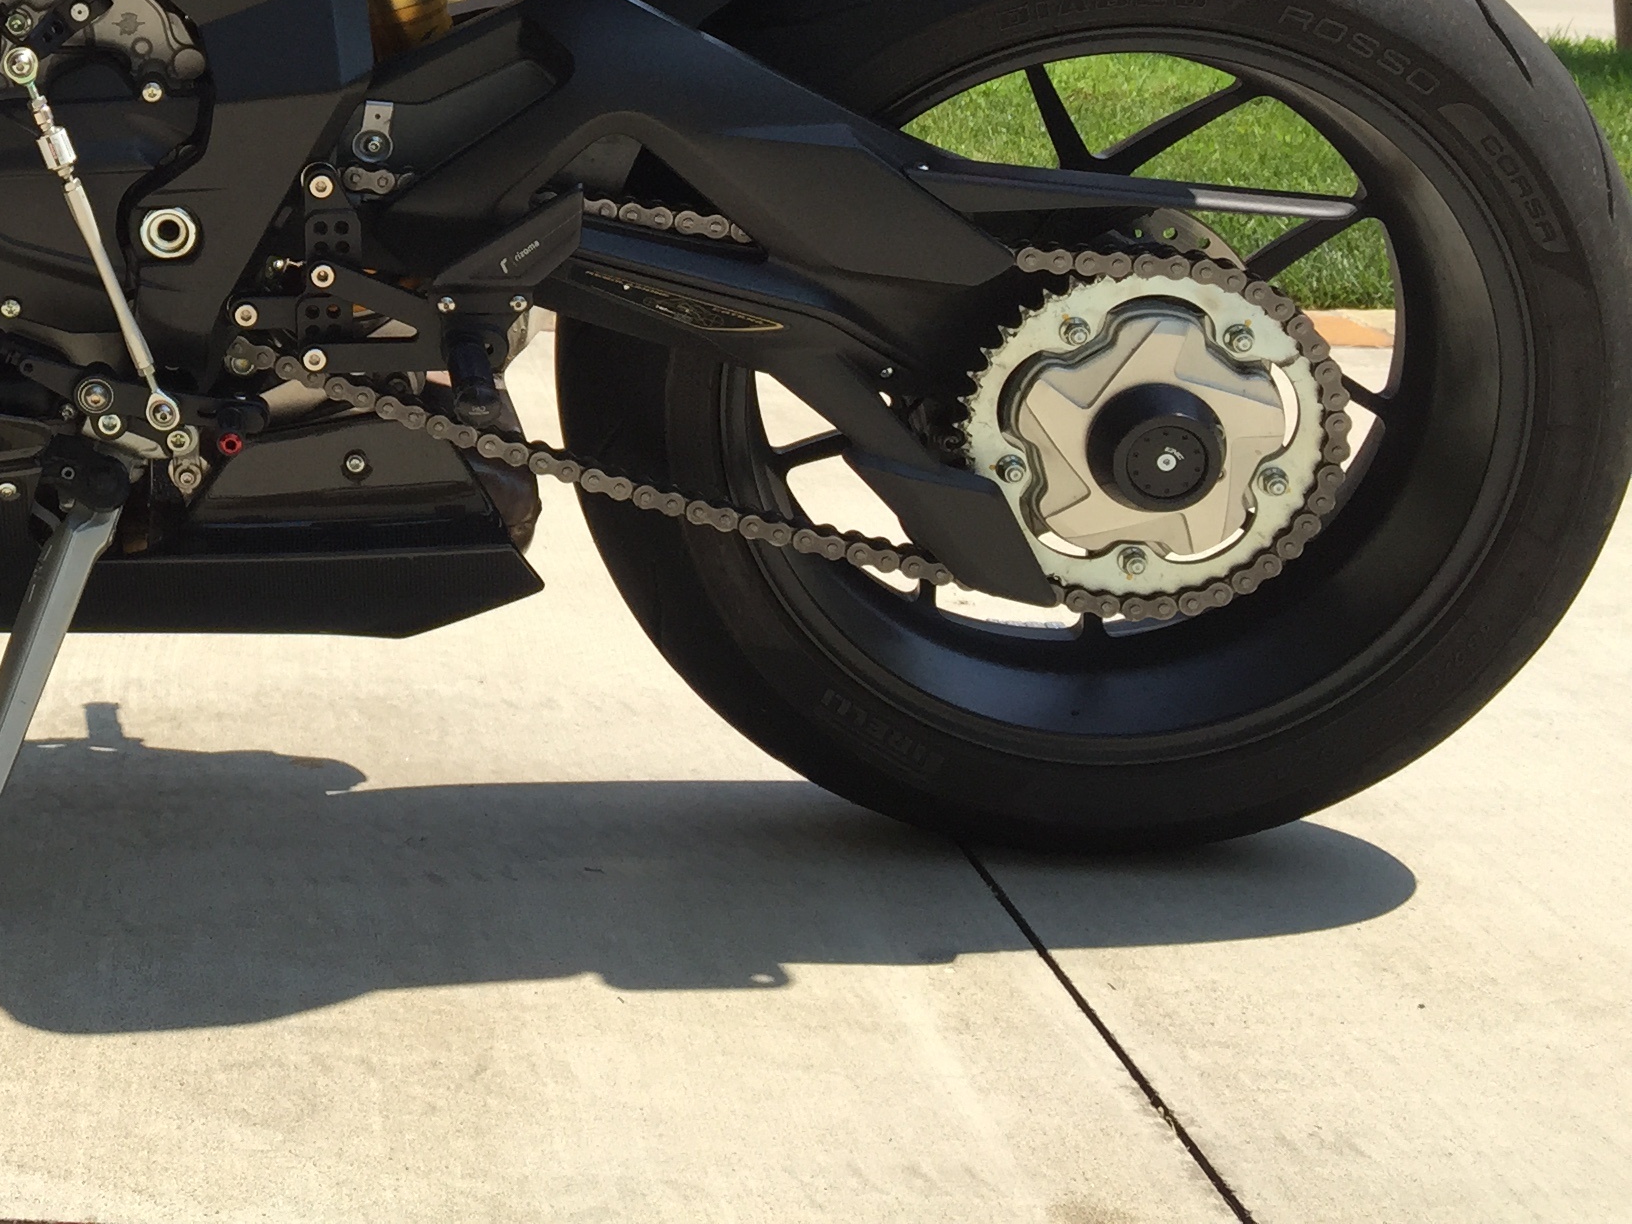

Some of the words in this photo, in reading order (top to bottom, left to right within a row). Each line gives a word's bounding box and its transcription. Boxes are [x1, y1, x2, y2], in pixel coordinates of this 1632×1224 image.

[1277, 5, 1441, 96] ROSSO
[1480, 135, 1563, 243] CORSA
[514, 240, 540, 262] rizoma
